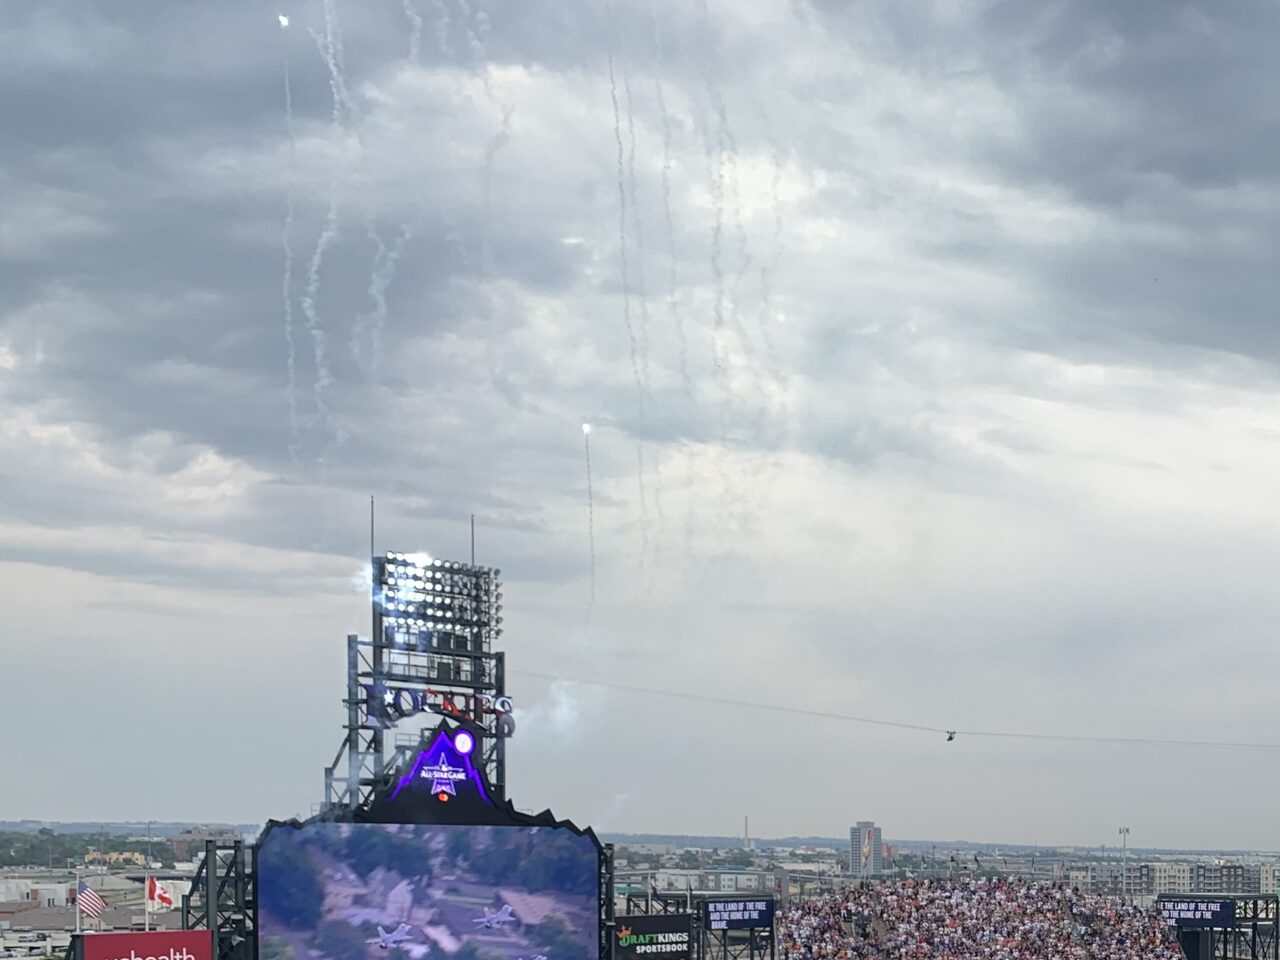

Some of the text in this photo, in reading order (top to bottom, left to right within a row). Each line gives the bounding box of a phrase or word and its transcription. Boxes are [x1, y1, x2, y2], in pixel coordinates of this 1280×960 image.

[755, 901, 766, 910] FREE
[1165, 902, 1174, 910] THE
[1174, 902, 1188, 910] LAND
[1208, 903, 1221, 911] FREE
[1203, 911, 1213, 919] THE
[619, 932, 689, 947] DRAFTKINGS
[635, 943, 689, 954] SPORTSBOOK
